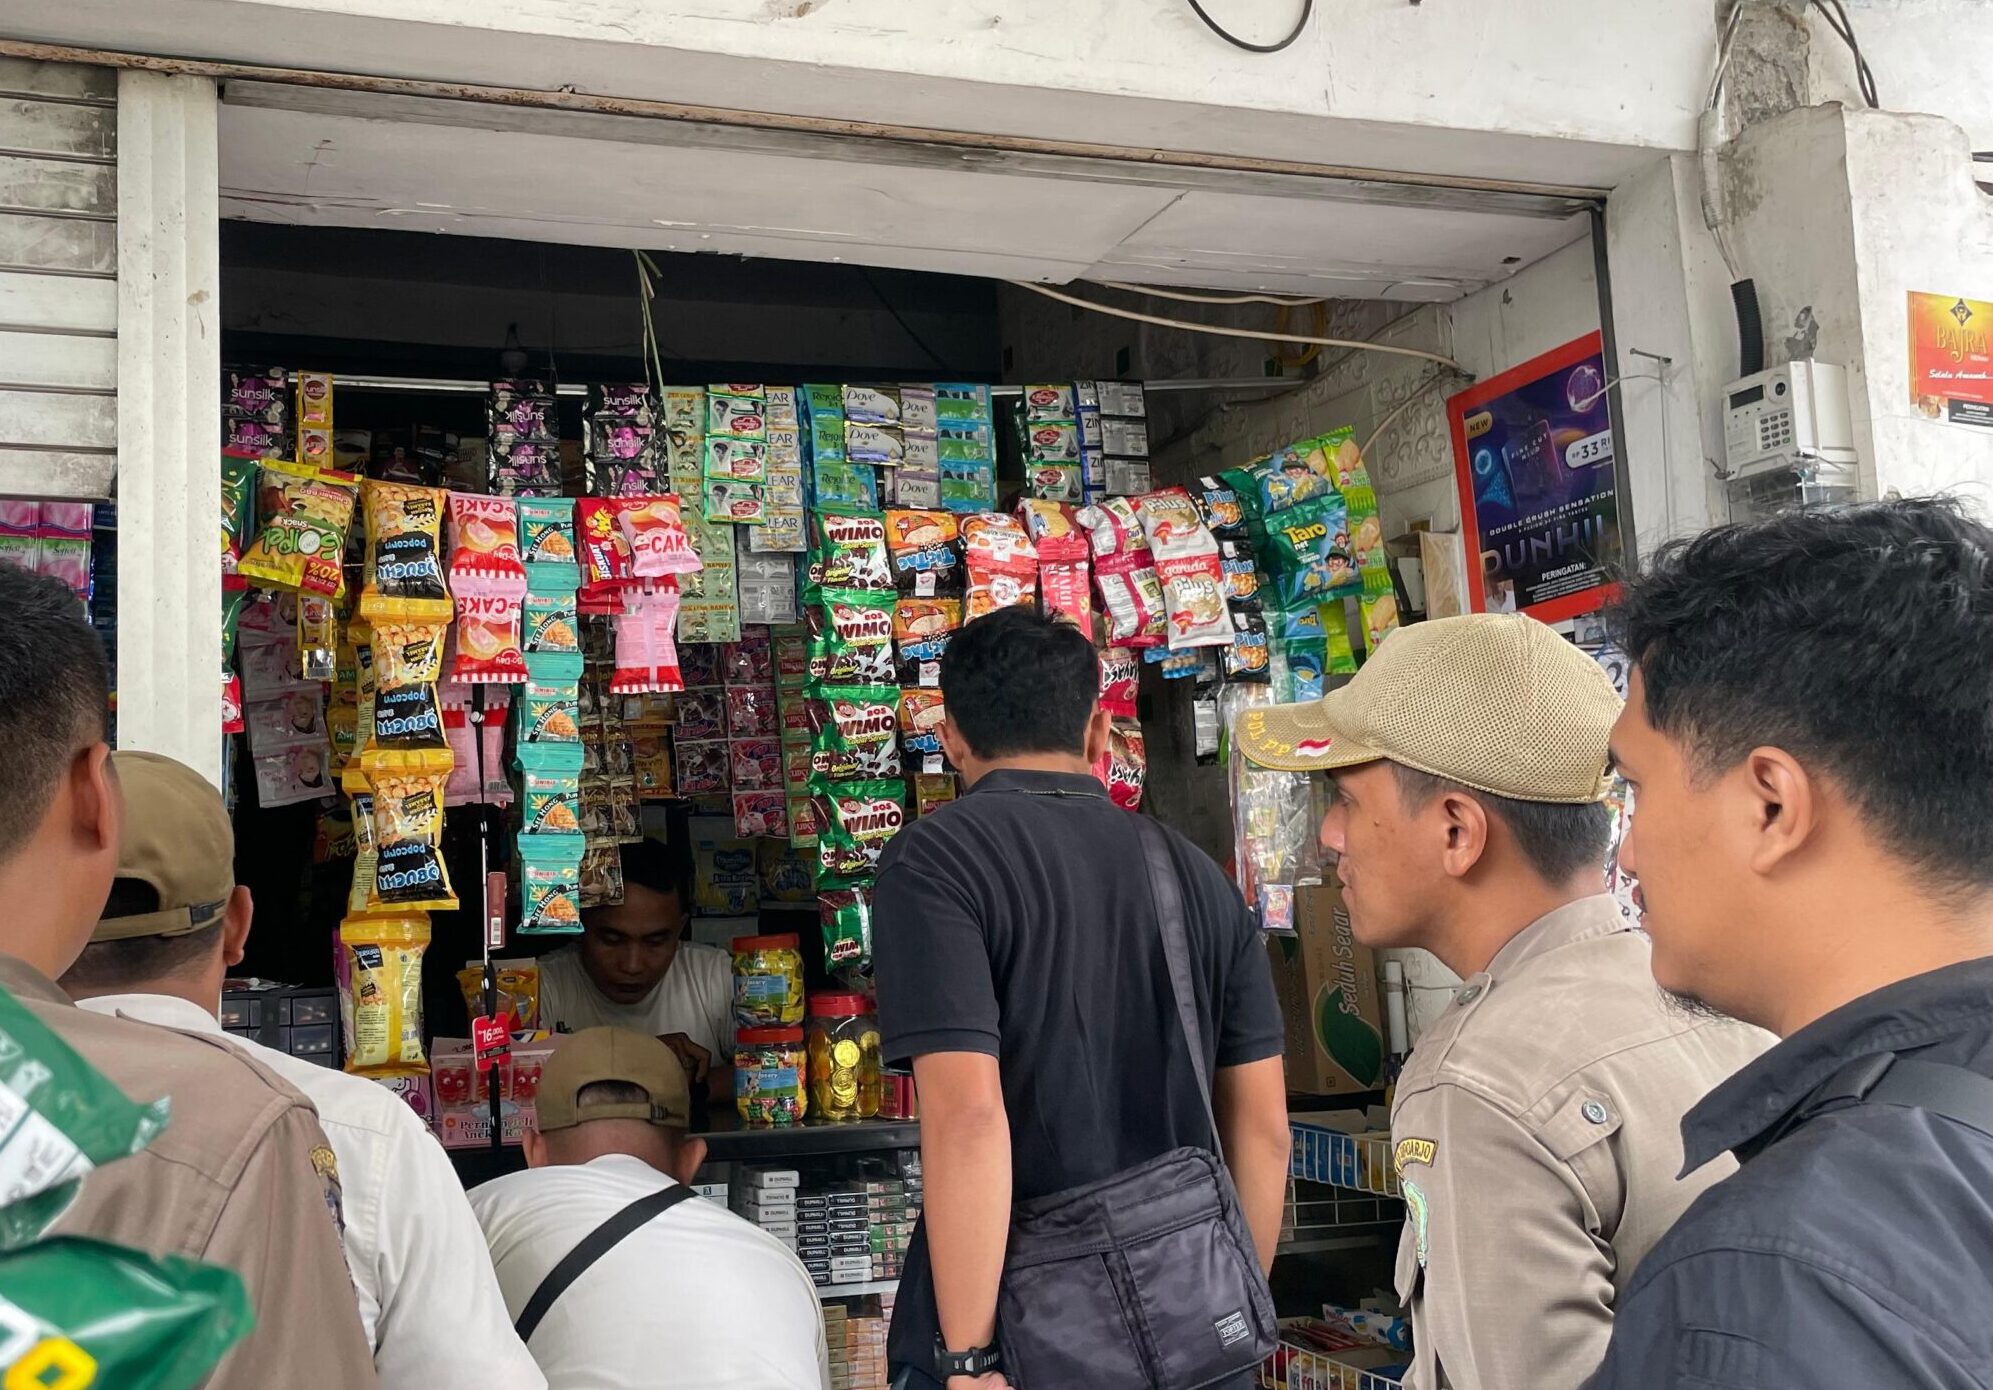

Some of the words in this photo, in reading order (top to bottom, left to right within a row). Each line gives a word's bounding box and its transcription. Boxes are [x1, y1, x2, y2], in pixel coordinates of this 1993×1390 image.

[1936, 326, 1988, 364] BAJRA
[231, 388, 276, 401] sunsilk
[603, 396, 643, 407] sunsilk
[766, 393, 789, 404] EAR
[846, 389, 877, 402] Dove
[901, 400, 928, 413] Dove
[505, 410, 545, 422] sunsilk
[1469, 419, 1489, 433] NEW
[229, 433, 273, 447] sunsilk
[769, 433, 793, 444] EAR
[849, 429, 880, 441] Dove
[1580, 440, 1599, 460] 33
[507, 454, 547, 468] sunsilk
[766, 475, 796, 486] LEAR
[900, 481, 929, 494] Dove
[1202, 490, 1235, 505] Pilus
[457, 499, 505, 515] CAKE
[1489, 519, 1524, 537] DOUBLE
[1525, 508, 1557, 525] CRUSH
[1558, 488, 1615, 513] SENSATION
[280, 518, 308, 529] Snack
[857, 519, 876, 527] BOS
[828, 526, 884, 542] WIMO
[1284, 523, 1328, 544] Taro
[650, 534, 686, 553] CAK
[1295, 540, 1310, 551] net
[307, 562, 341, 582] 20%
[1164, 561, 1208, 578] garuda
[1222, 559, 1255, 573] Pilus
[1173, 577, 1214, 597] Pilus
[458, 596, 507, 614] CAKE
[864, 612, 884, 621] BOS
[1234, 632, 1267, 648] Pilus
[383, 690, 427, 704] Popcorn
[867, 707, 887, 717] BOS
[839, 715, 895, 737] WIMO
[872, 802, 892, 813] BOS
[844, 811, 901, 833] WIMO
[382, 843, 427, 860] Popcorn
[1331, 906, 1354, 960] Segar
[1331, 963, 1361, 1017] Seduh
